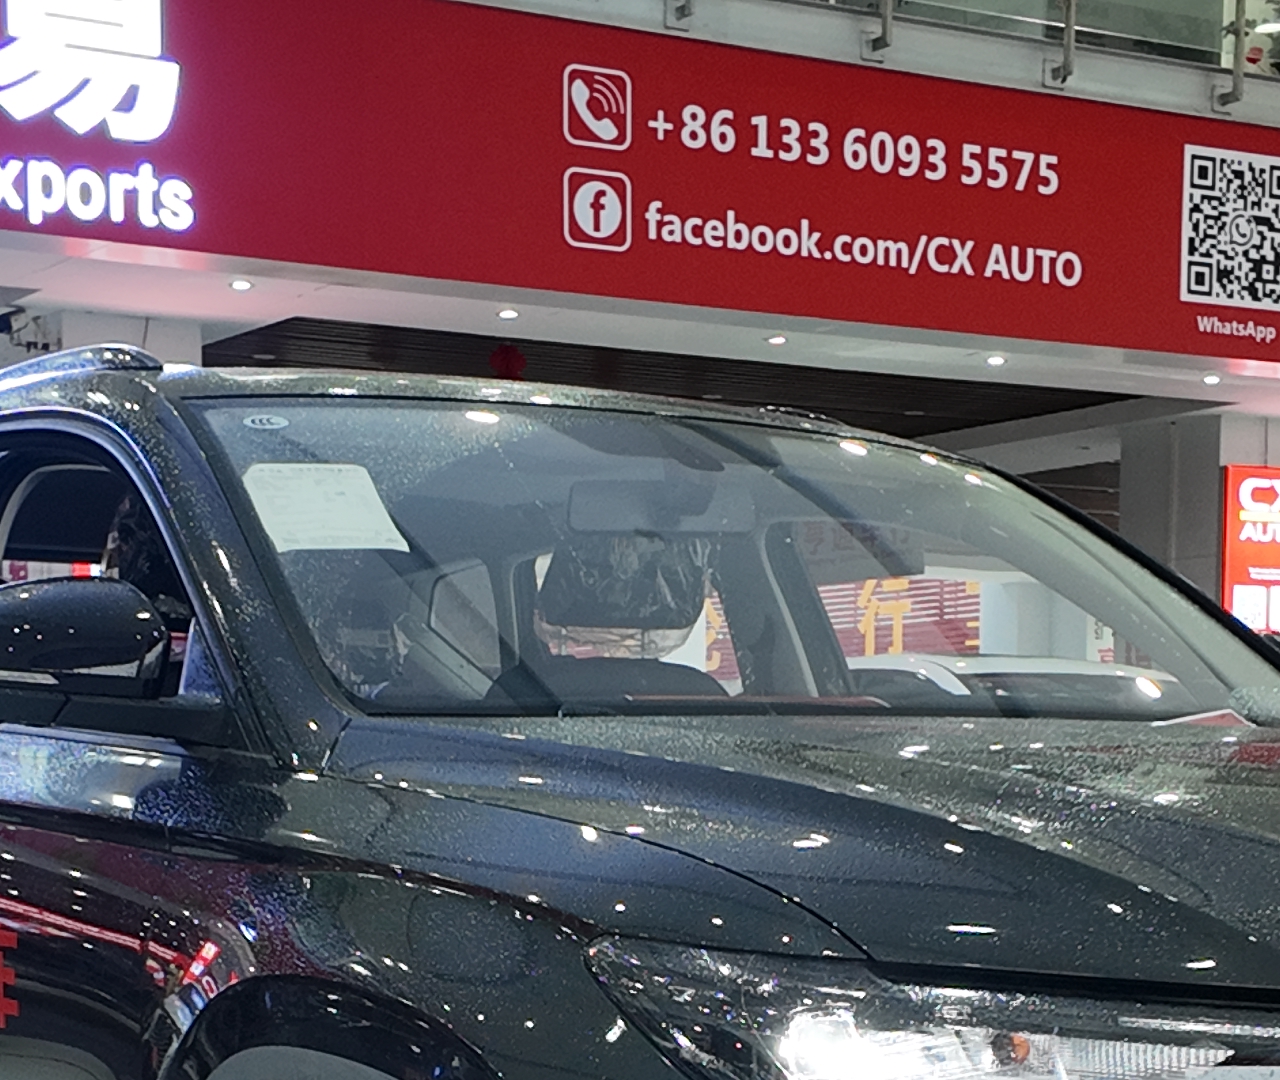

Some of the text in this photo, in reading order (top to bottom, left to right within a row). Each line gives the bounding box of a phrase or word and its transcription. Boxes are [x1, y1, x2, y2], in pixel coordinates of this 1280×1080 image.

[647, 103, 1060, 196] +86 133 6093 5575
[644, 201, 1083, 288] facebook.com/CX AUTO
[1197, 316, 1277, 343] WhatsApp
